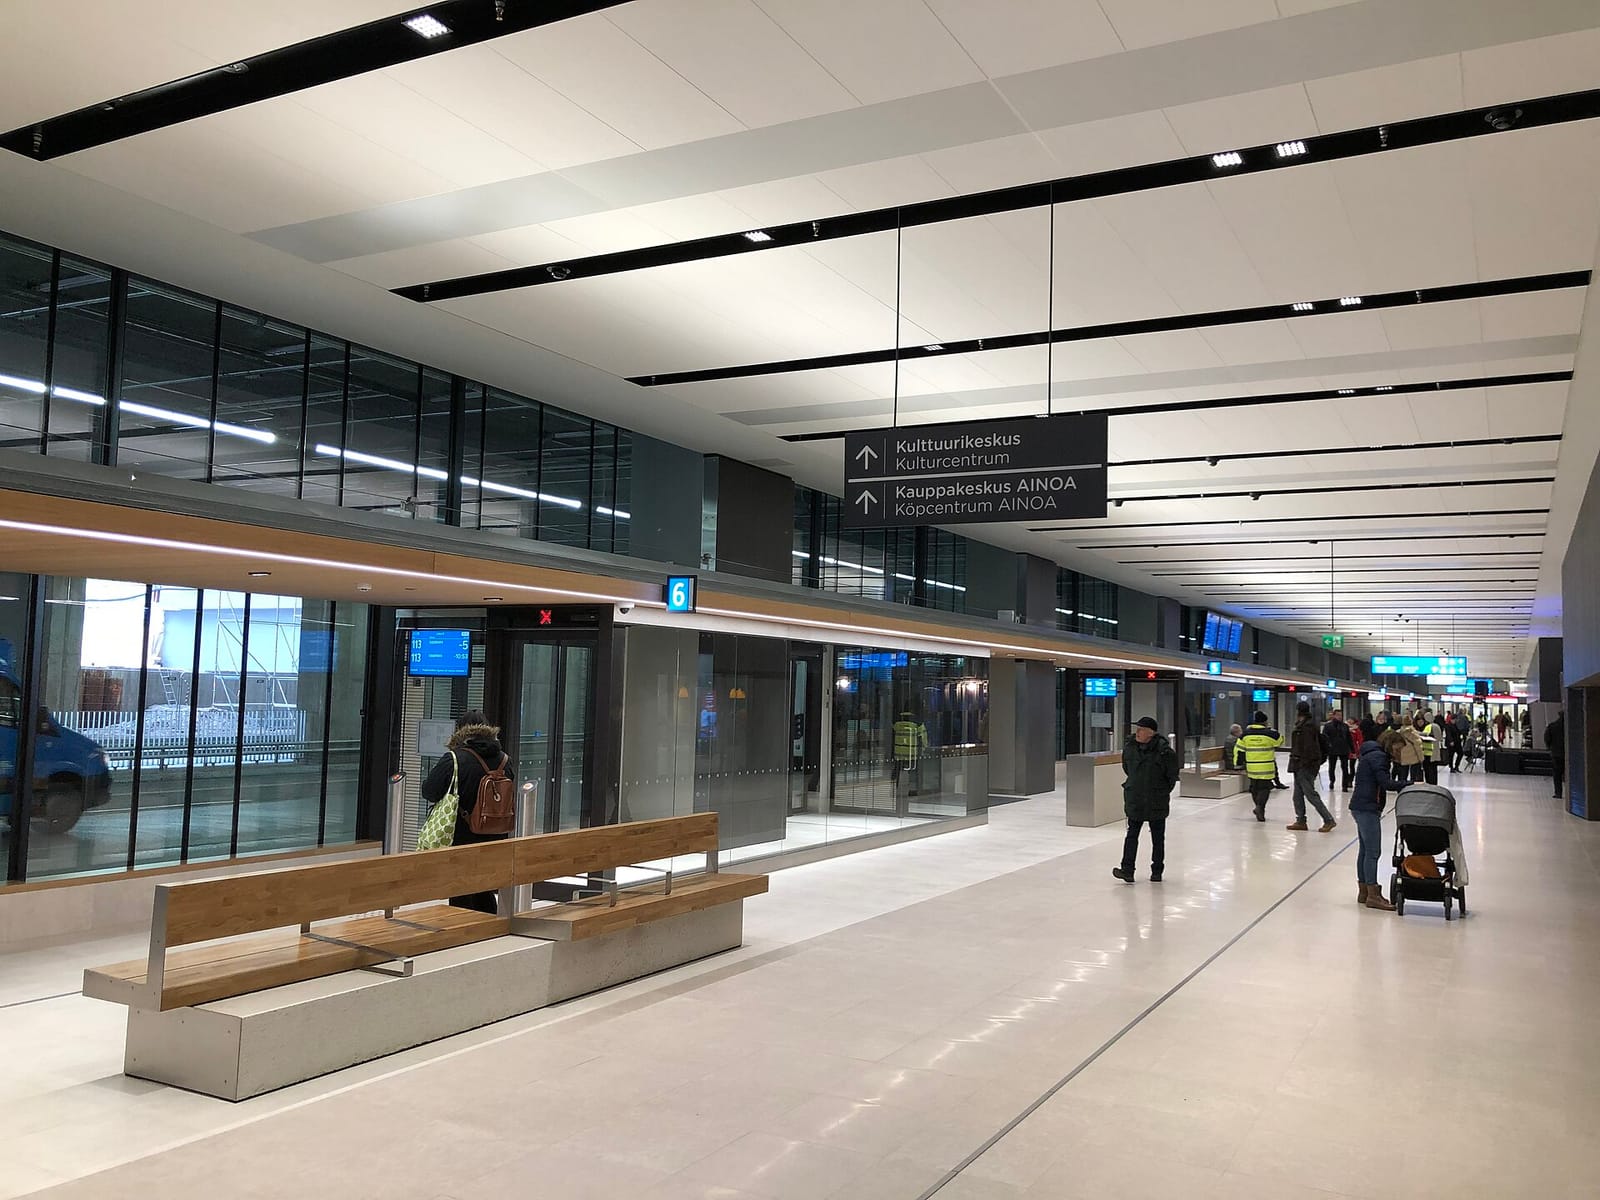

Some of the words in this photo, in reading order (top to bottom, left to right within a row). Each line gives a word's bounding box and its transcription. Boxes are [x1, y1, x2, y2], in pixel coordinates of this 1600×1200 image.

[896, 433, 1021, 454] Kulttuurikeskus
[895, 451, 1010, 471] Kulturcentrum
[895, 479, 1012, 500] Kauppakeskus
[1017, 476, 1077, 493] AINOA
[895, 499, 993, 518] Köpcentrum
[998, 495, 1057, 512] AINOA
[672, 582, 685, 607] 6
[412, 640, 422, 648] 113
